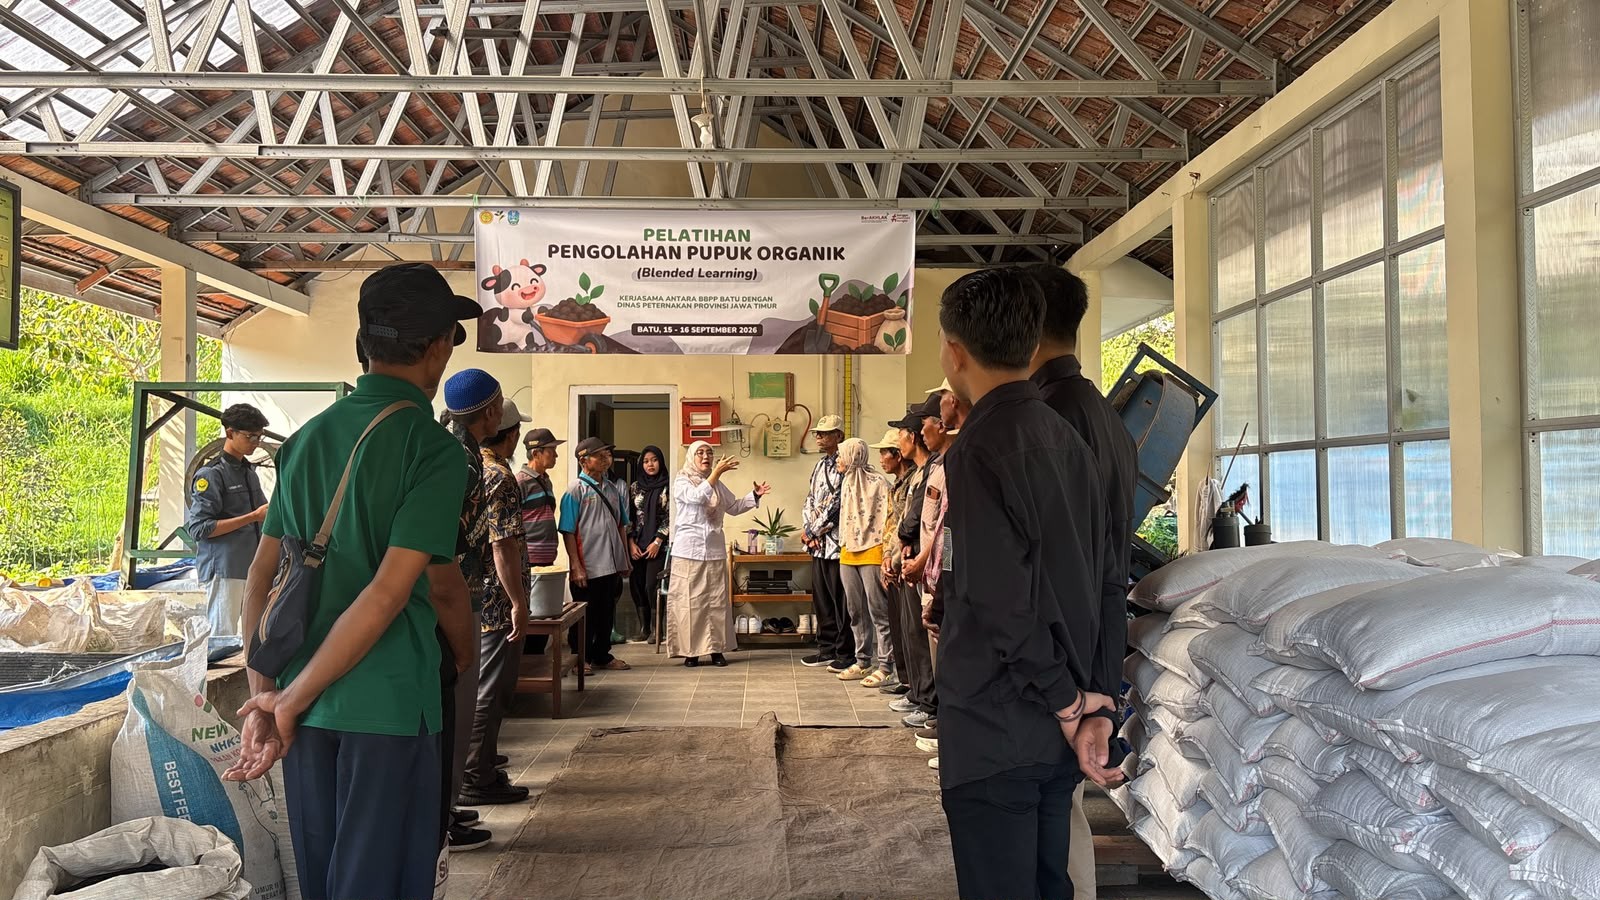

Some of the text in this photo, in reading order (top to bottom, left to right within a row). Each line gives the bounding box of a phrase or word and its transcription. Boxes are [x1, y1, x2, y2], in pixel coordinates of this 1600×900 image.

[643, 228, 751, 242] PELATIHAN
[548, 244, 846, 261] PENGOLAHAN PUPUK ORGANIK
[637, 267, 758, 281] (Blended Learning)
[637, 326, 662, 334] BATU,
[191, 722, 229, 742] NEW
[164, 761, 185, 795] BEST
